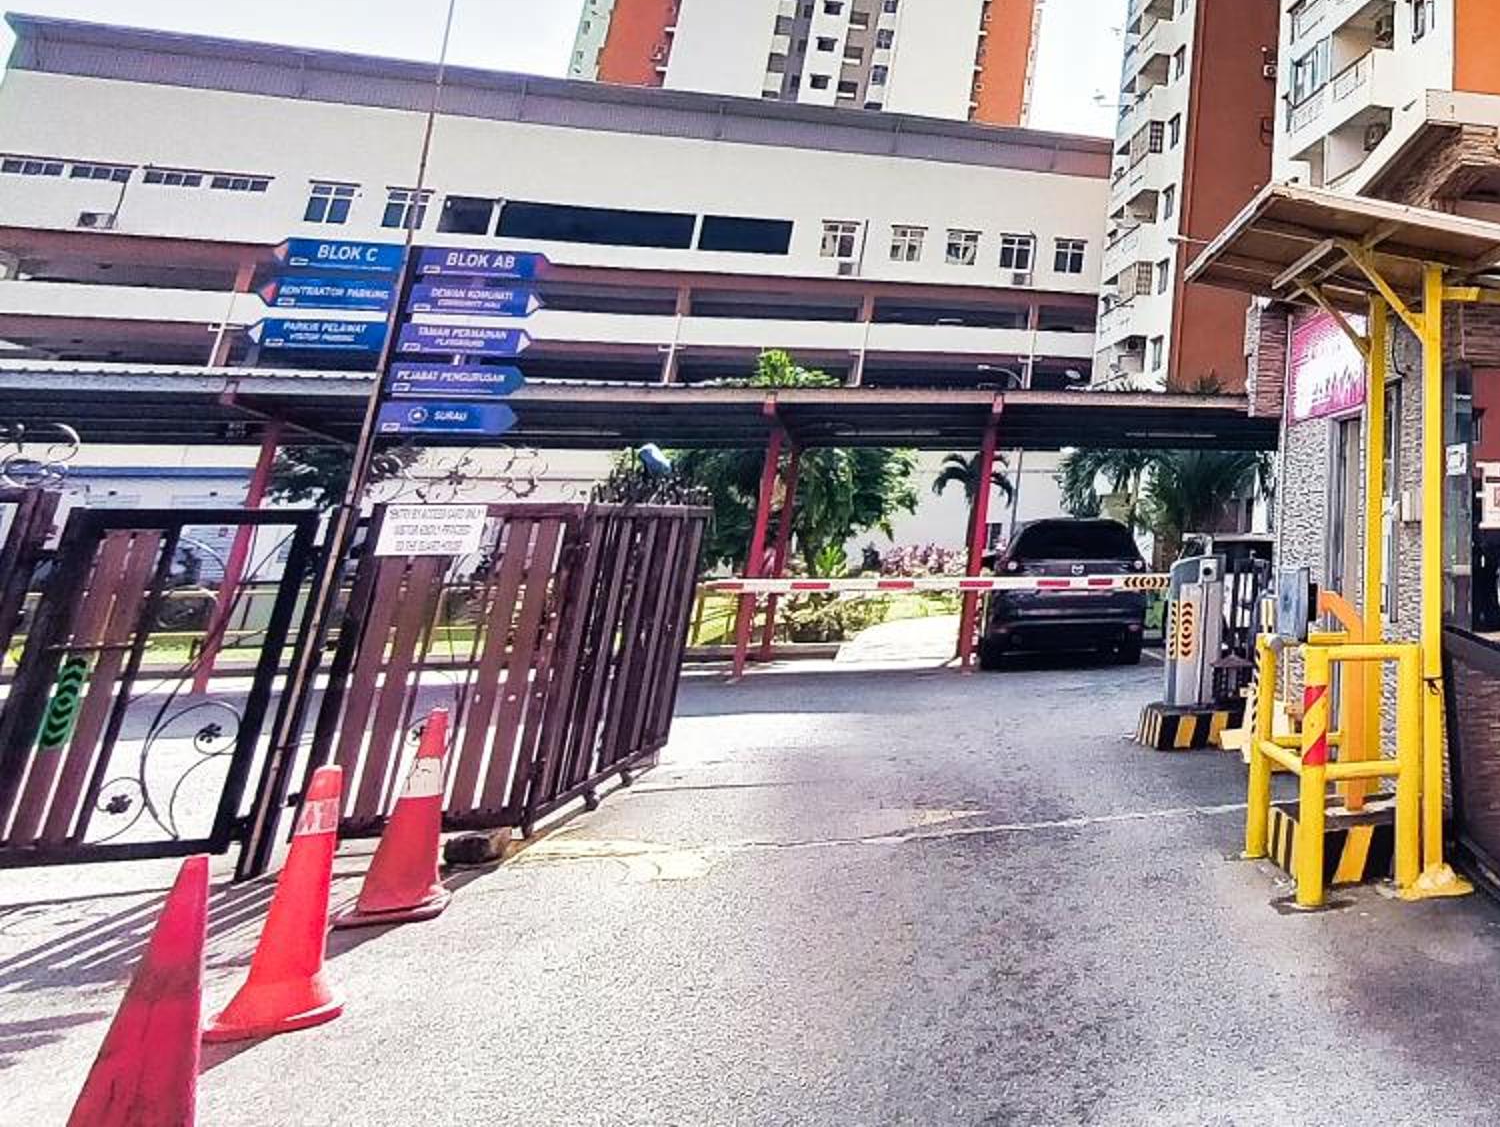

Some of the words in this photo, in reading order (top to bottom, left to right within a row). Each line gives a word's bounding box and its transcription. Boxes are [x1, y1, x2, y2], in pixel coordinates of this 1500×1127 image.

[318, 244, 362, 260] BLOK
[366, 247, 379, 262] C
[446, 252, 490, 267] BLOK
[492, 255, 515, 269] AB
